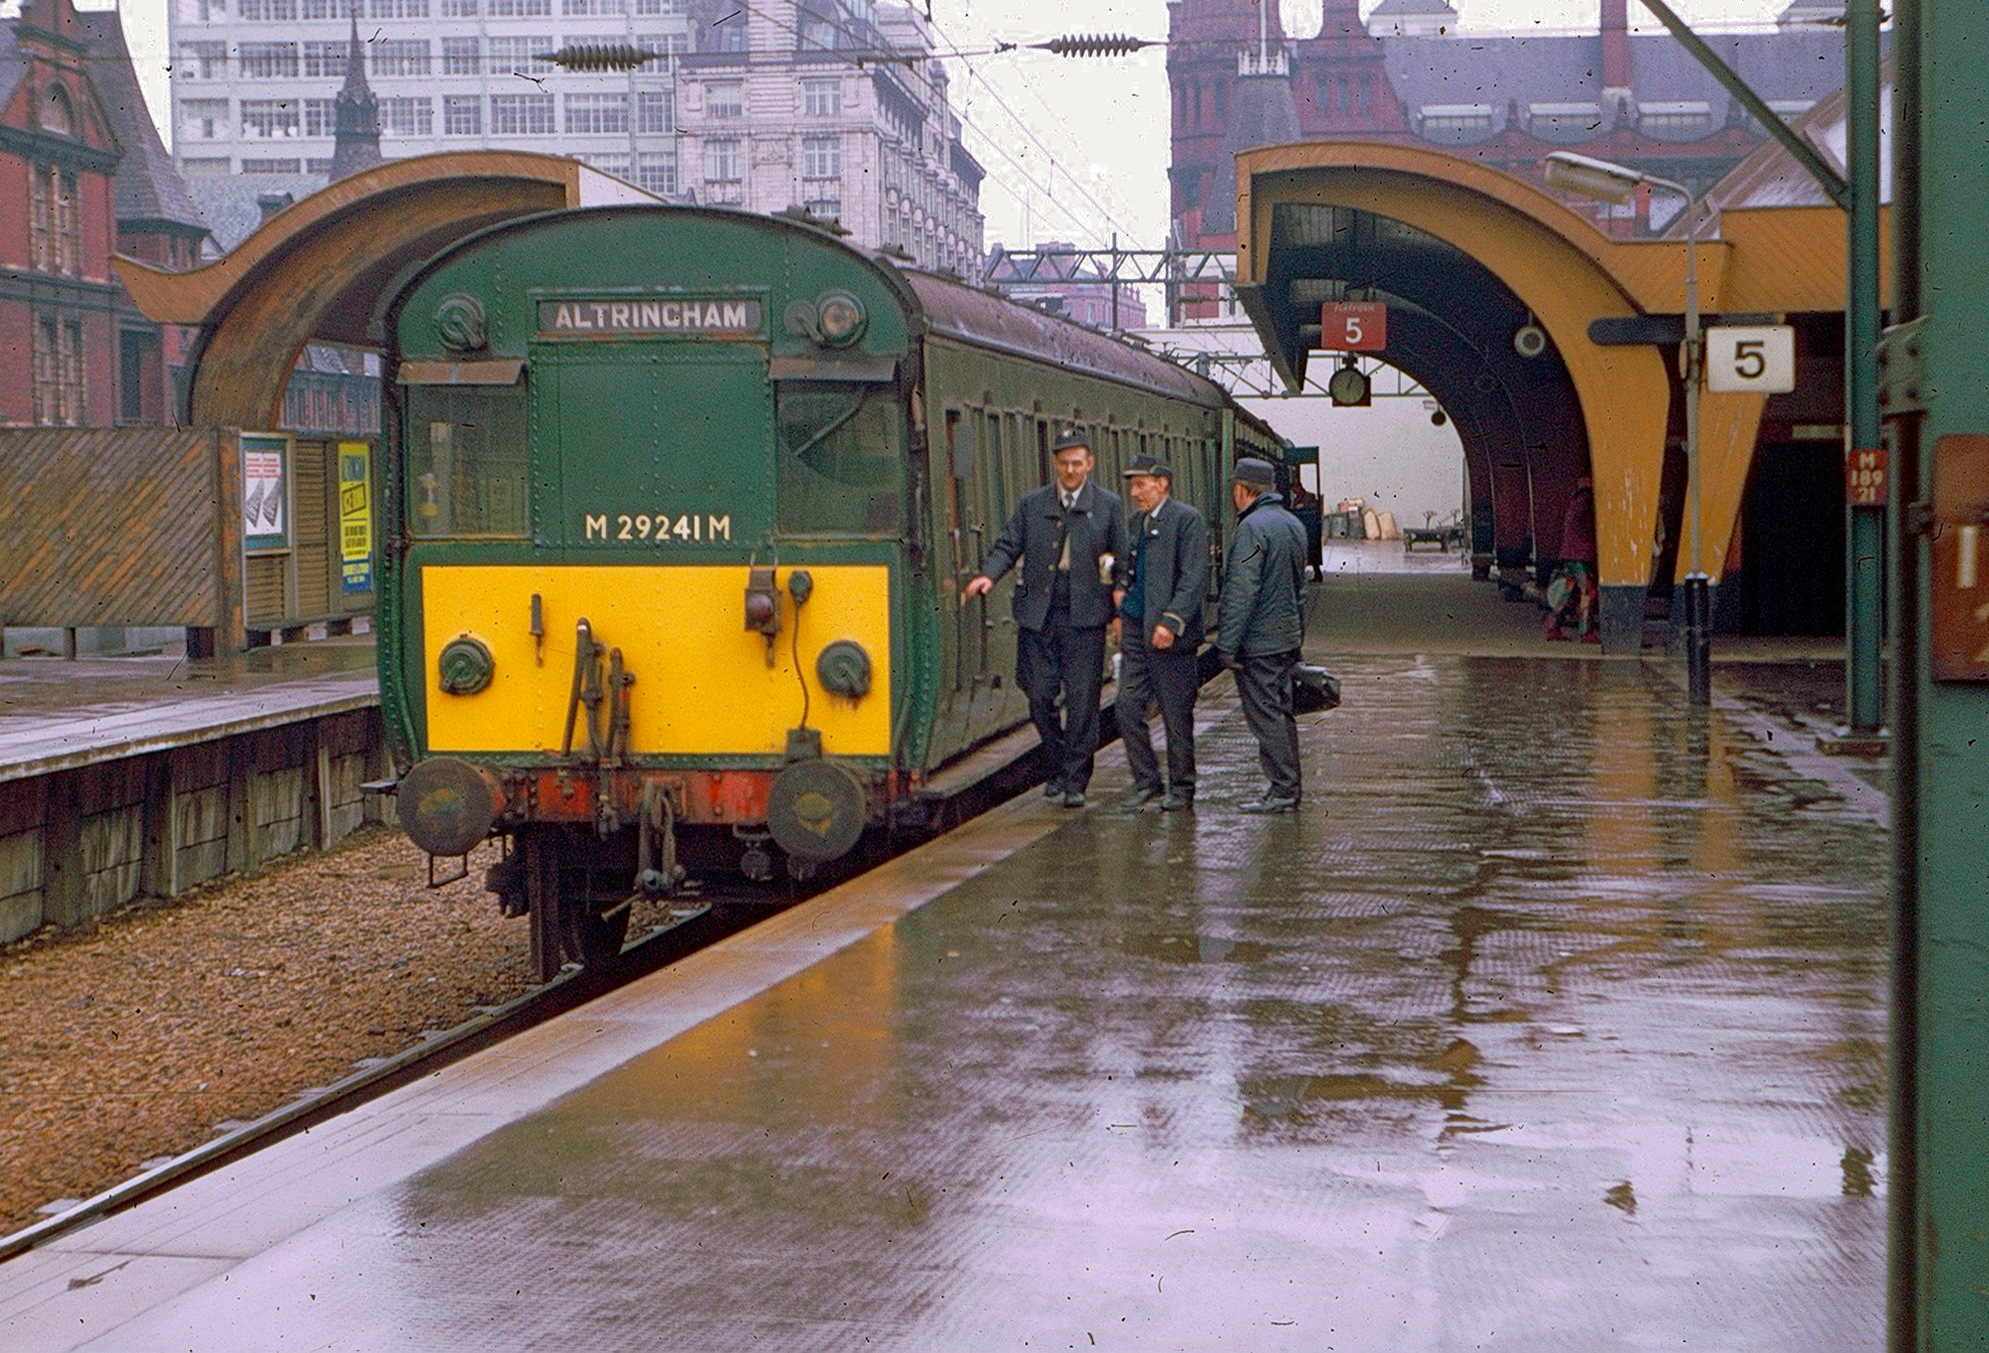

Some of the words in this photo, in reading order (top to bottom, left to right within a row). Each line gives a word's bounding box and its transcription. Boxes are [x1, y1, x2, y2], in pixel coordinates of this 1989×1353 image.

[555, 302, 747, 328] ALTRINCHAM
[1345, 317, 1363, 344] 5
[1734, 340, 1766, 379] 5
[1860, 453, 1875, 469] M
[1851, 469, 1883, 487] 189
[586, 514, 607, 539] M
[617, 514, 700, 541] 29241
[708, 514, 730, 540] M
